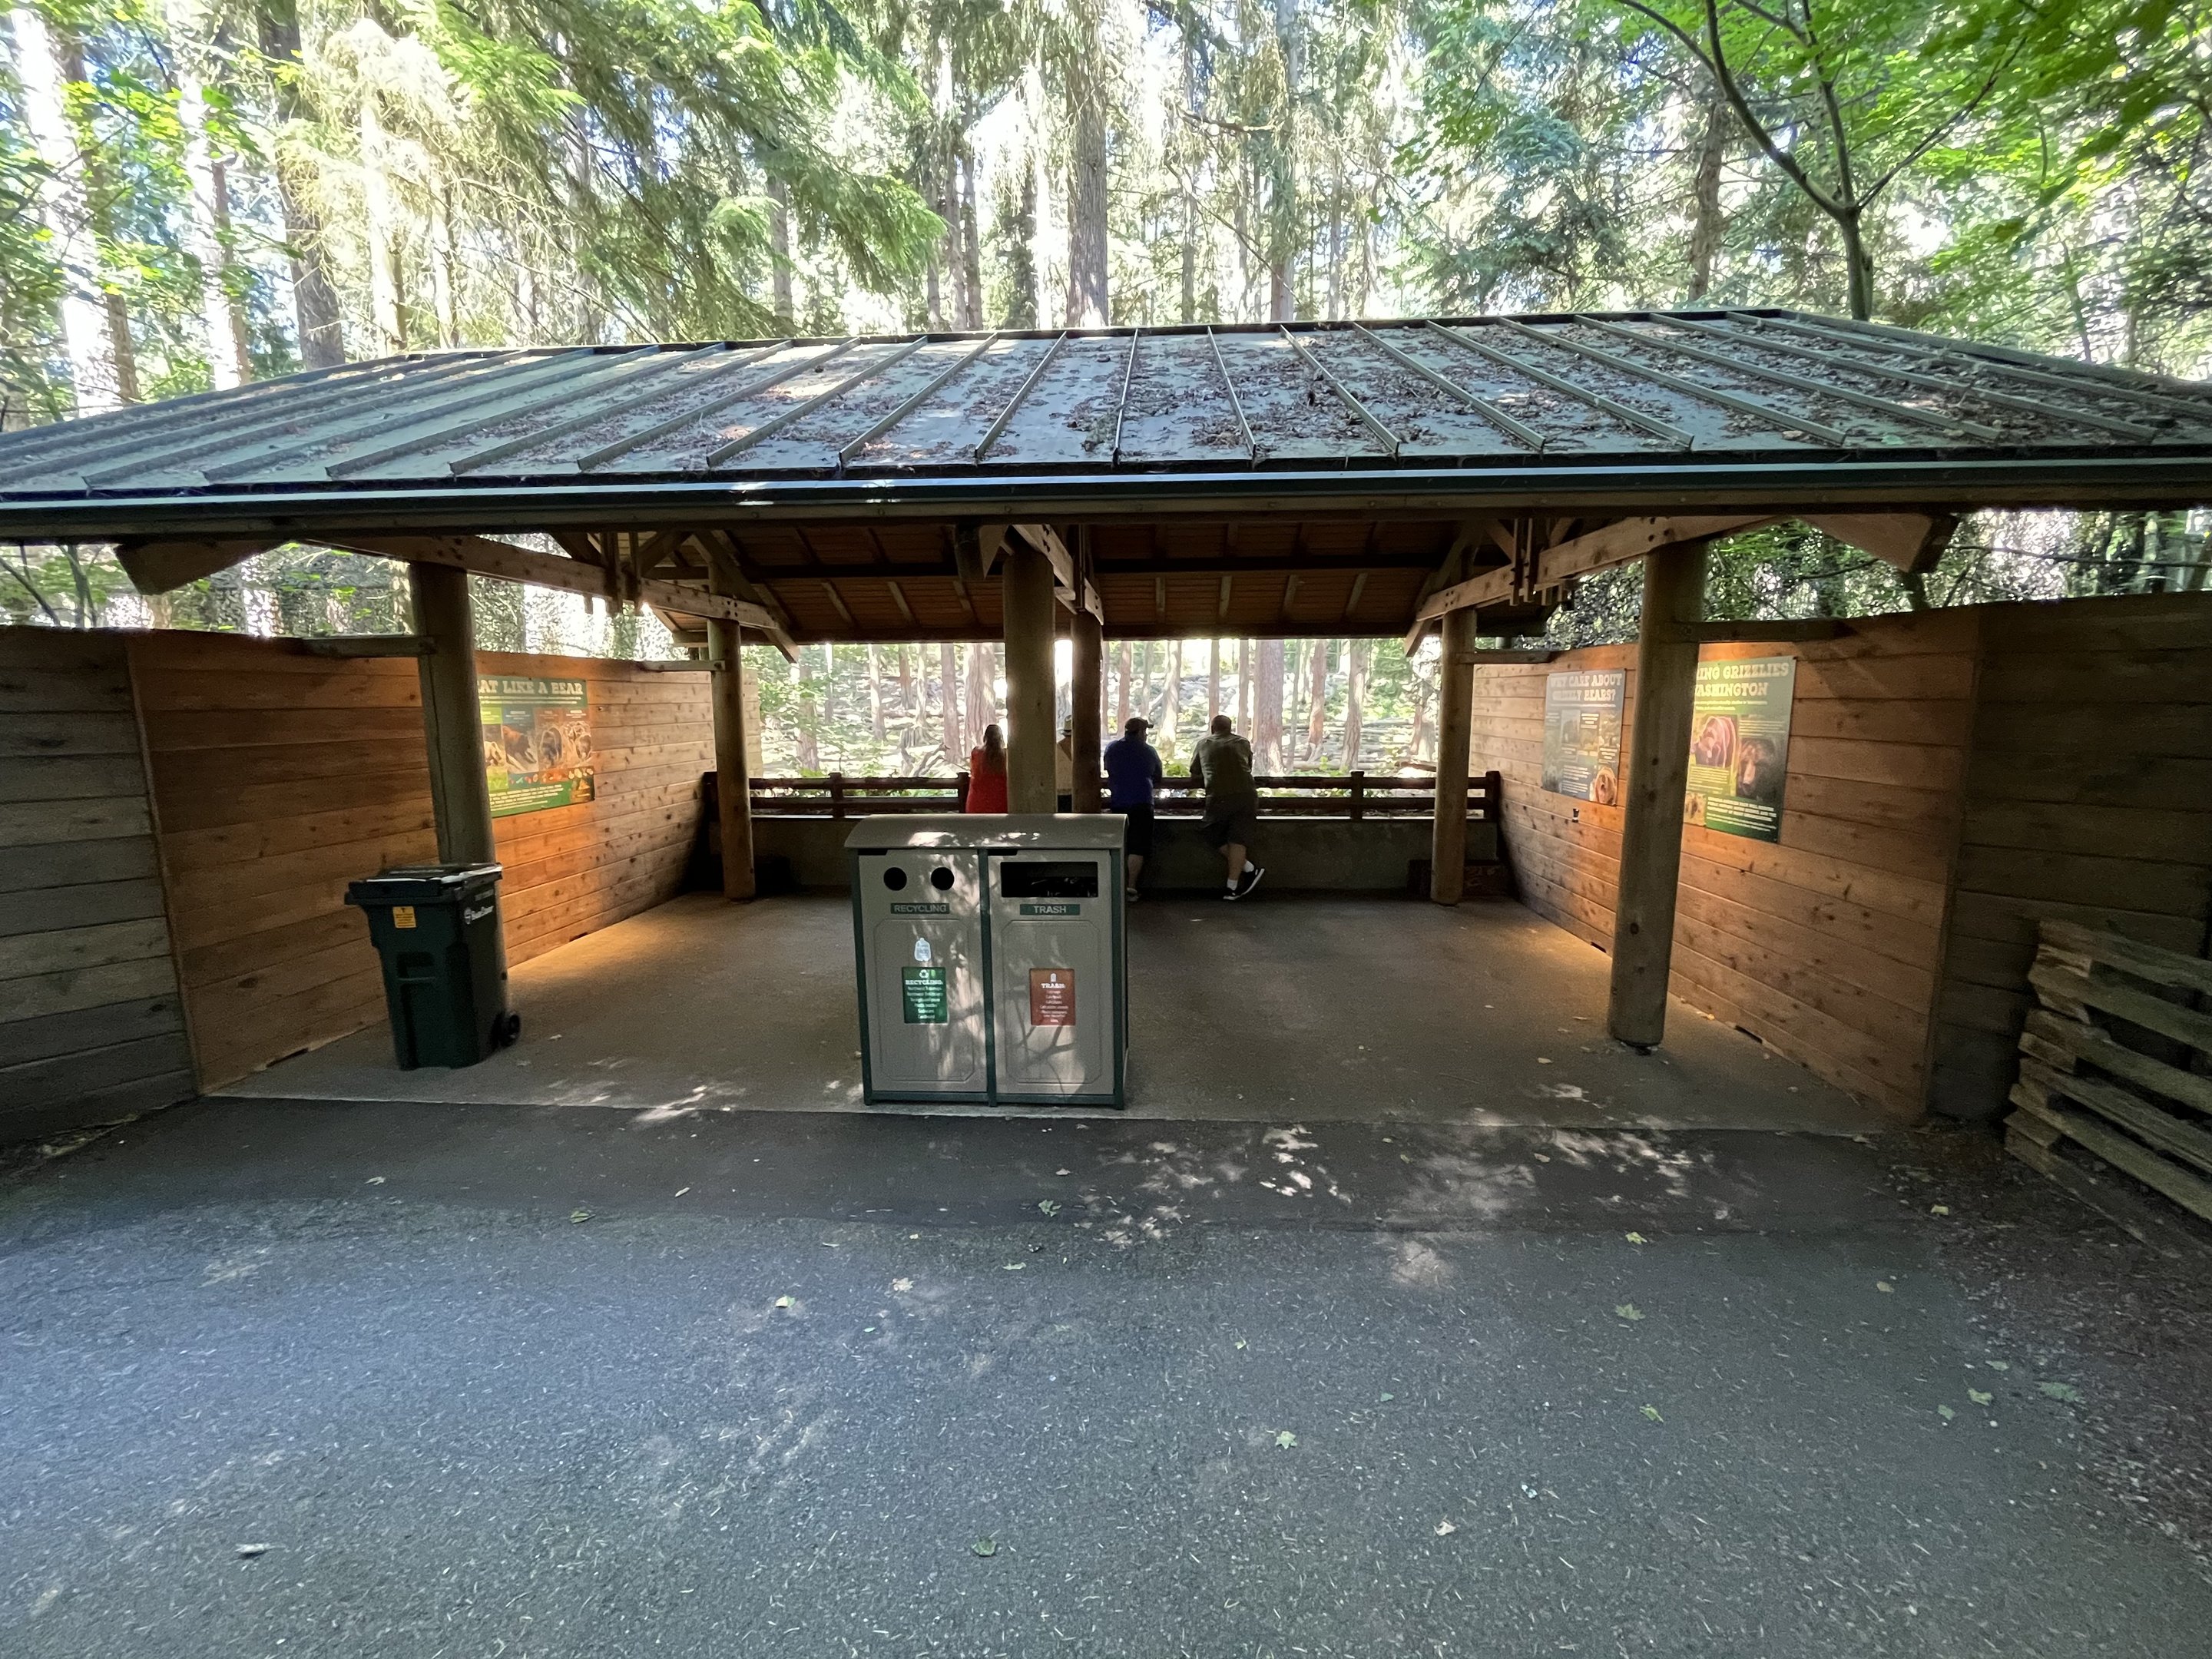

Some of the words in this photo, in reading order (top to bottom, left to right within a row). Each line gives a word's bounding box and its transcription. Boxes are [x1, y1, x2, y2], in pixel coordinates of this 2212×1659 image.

[1723, 663, 1790, 679] GRIZZLIES
[1550, 677, 1568, 687] WHY
[1569, 675, 1590, 687] CARE
[1591, 674, 1622, 687] ABOUT
[502, 680, 535, 694] LIKE
[538, 682, 548, 694] A
[551, 682, 584, 695] BEAR
[1552, 690, 1582, 701] GRIZZLY
[894, 904, 946, 912] RECYCLING
[1033, 905, 1067, 913] TRASH
